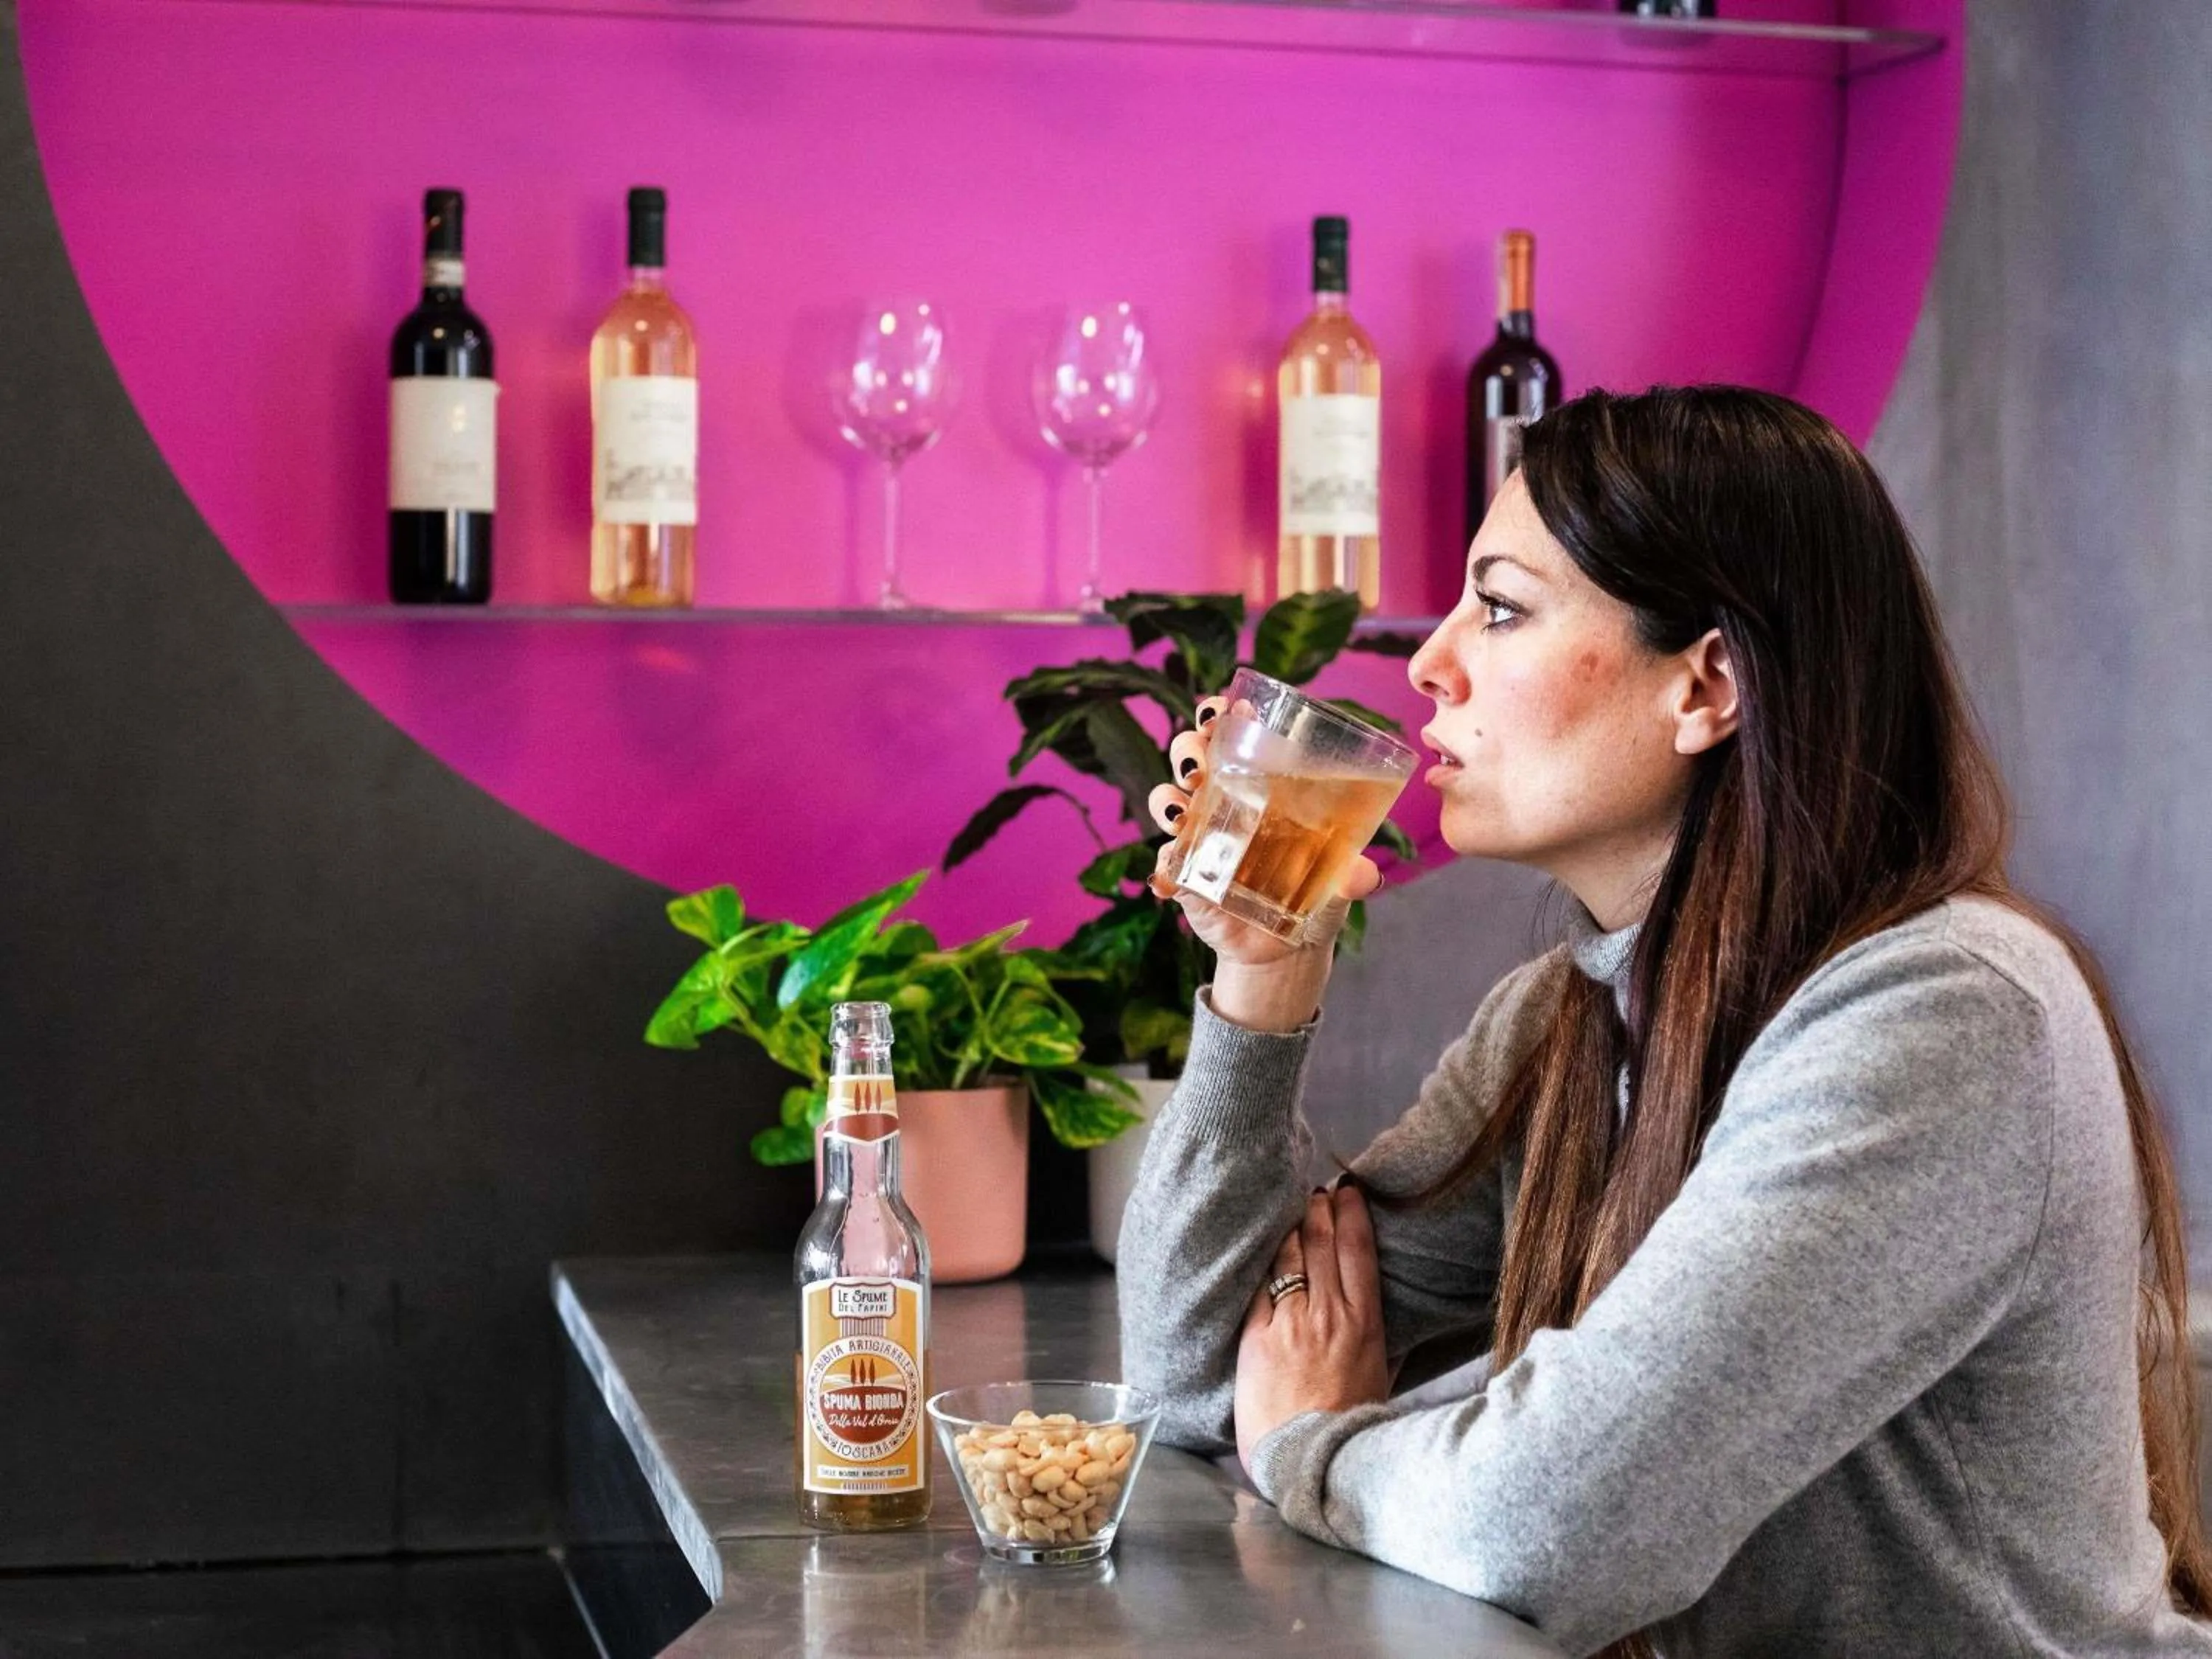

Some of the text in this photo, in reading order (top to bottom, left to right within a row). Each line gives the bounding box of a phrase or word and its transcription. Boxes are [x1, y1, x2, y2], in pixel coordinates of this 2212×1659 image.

[849, 1339, 911, 1371] ARTIGIANALE
[824, 1391, 904, 1411] SPUMA BIONDA
